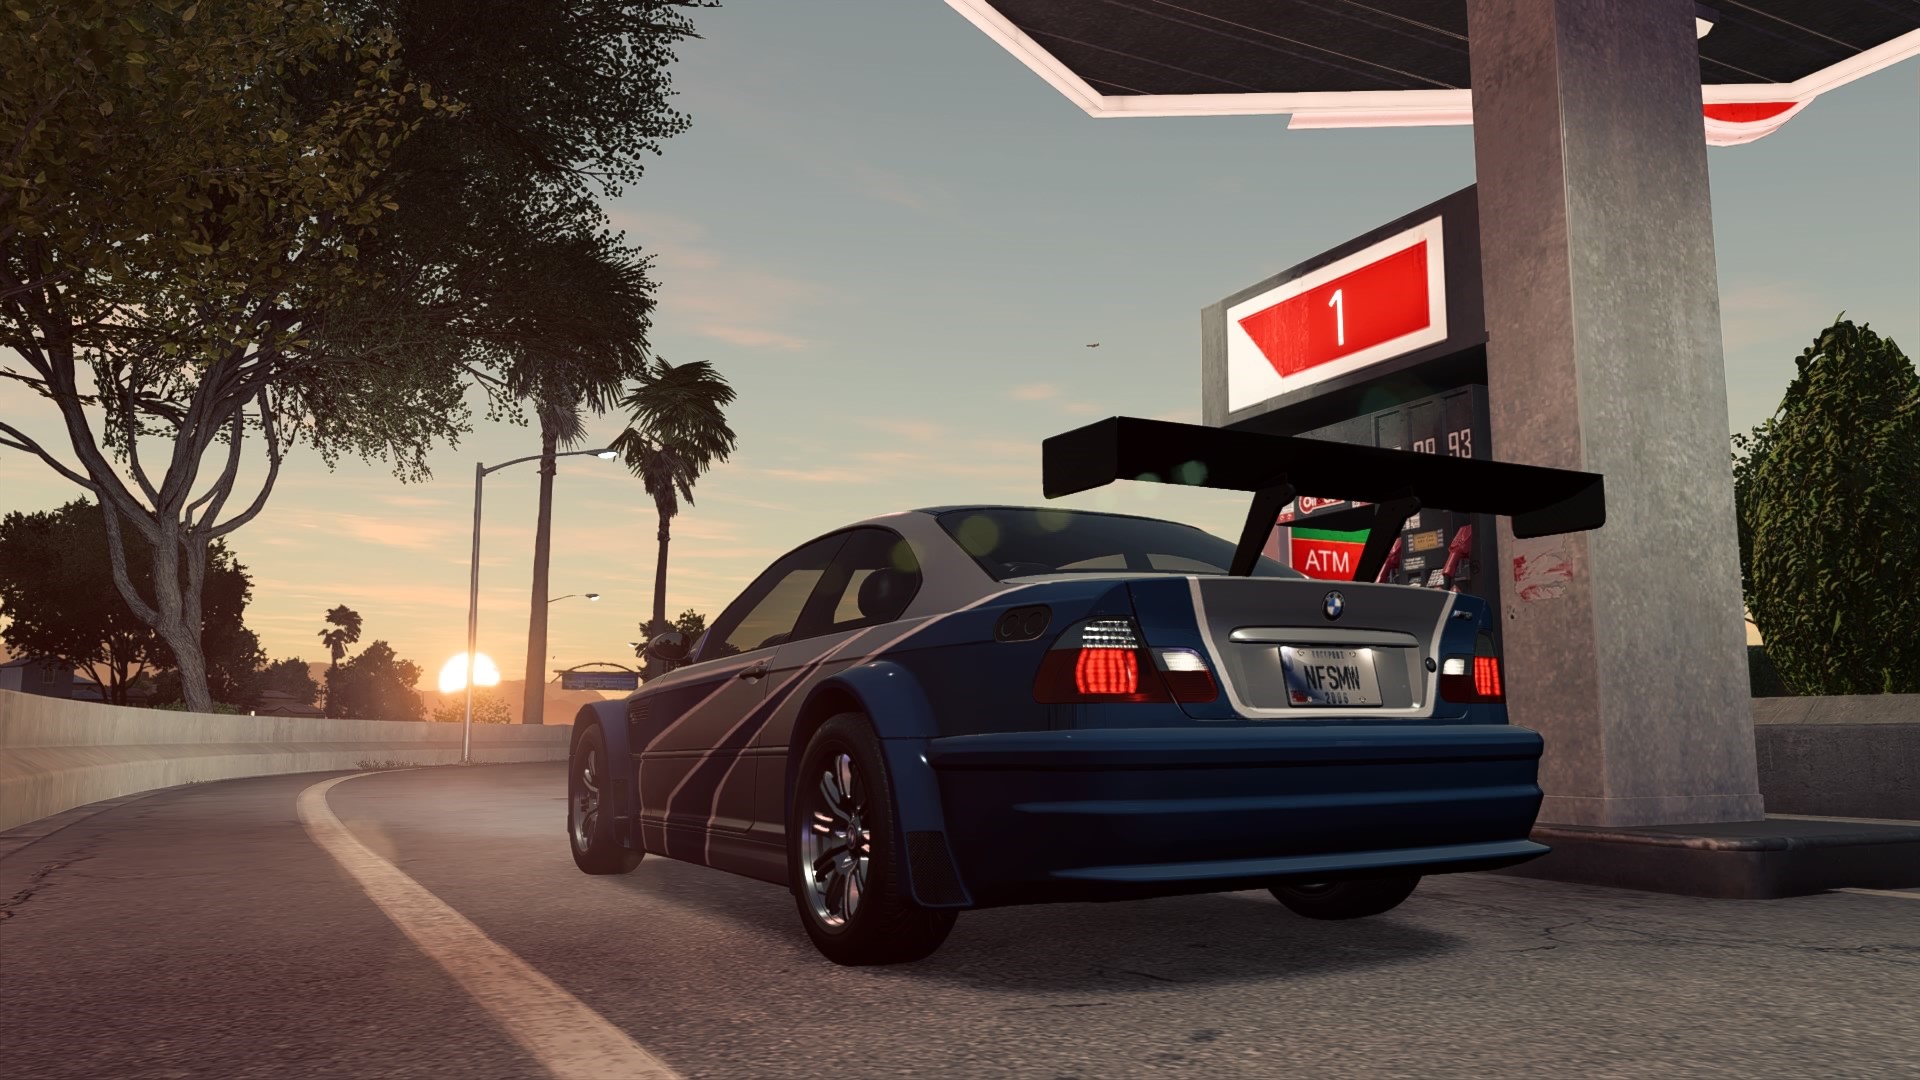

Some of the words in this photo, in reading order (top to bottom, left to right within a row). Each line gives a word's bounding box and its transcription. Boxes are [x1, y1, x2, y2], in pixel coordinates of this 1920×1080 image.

[1328, 289, 1344, 346] 1
[1448, 428, 1472, 459] 93
[1305, 549, 1349, 573] ATM
[1304, 665, 1360, 690] NFSMW
